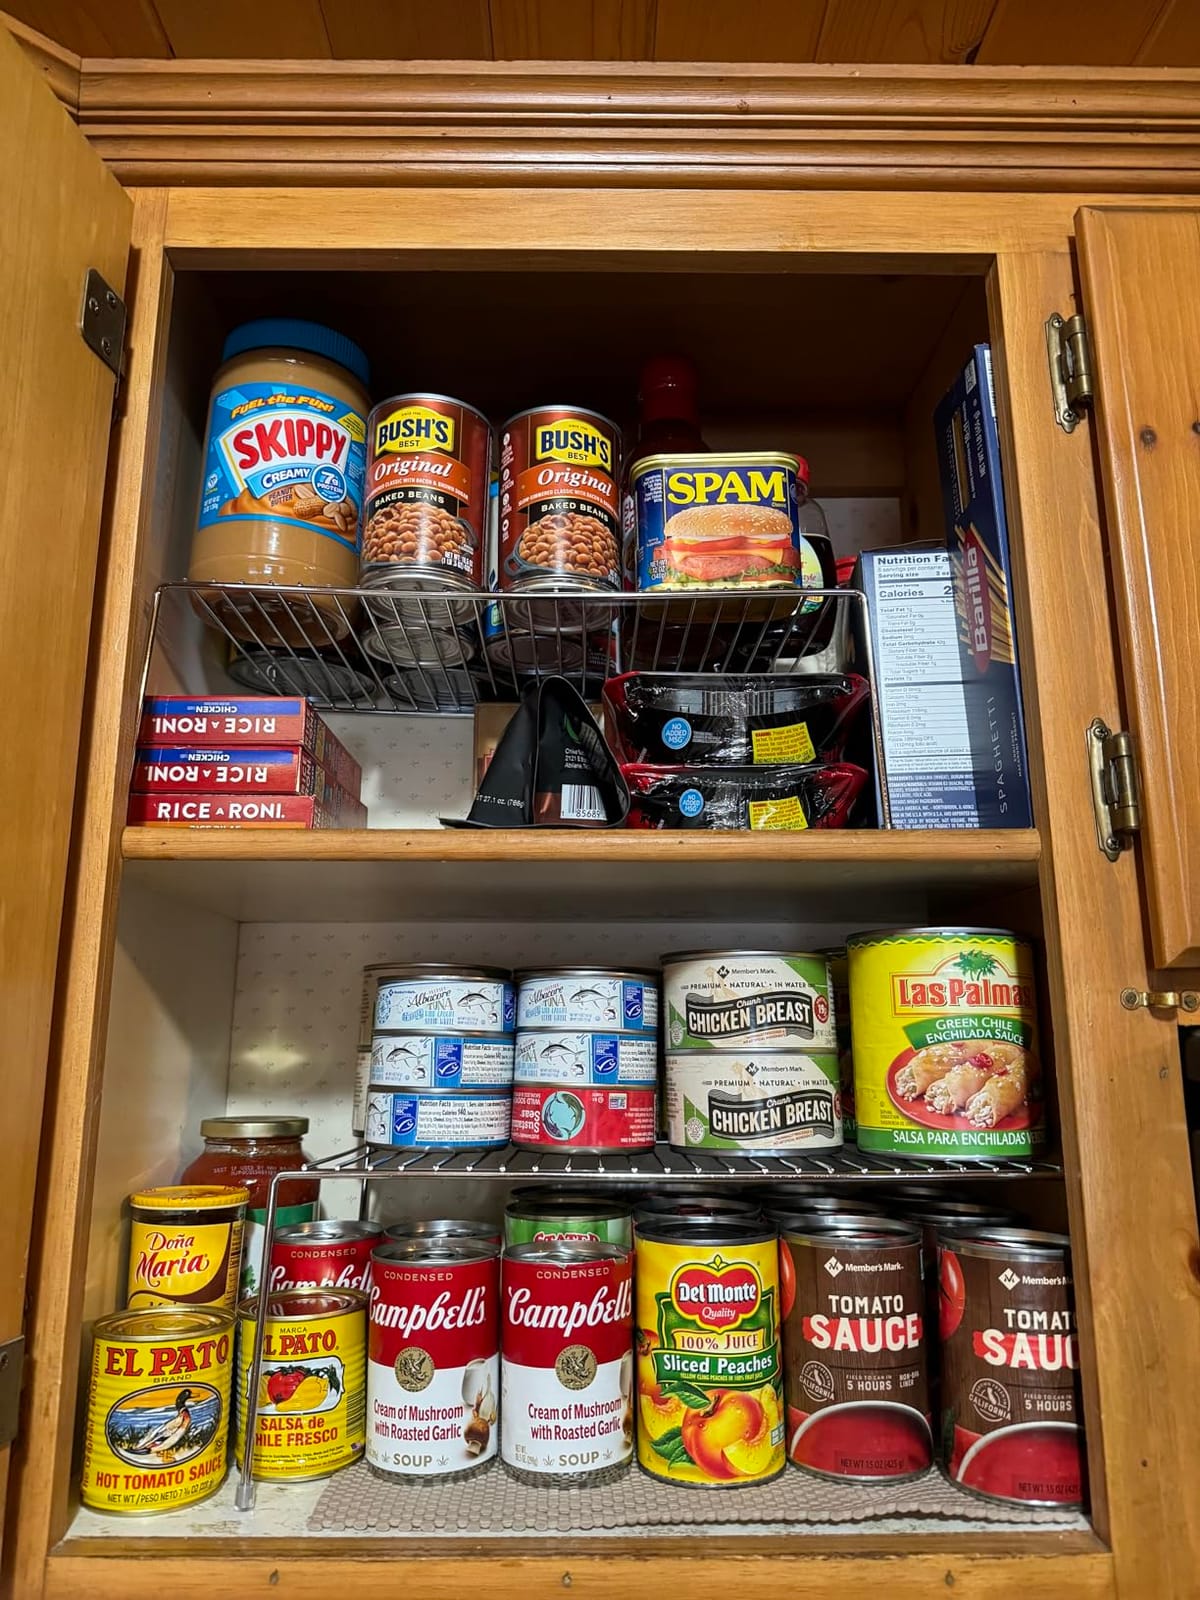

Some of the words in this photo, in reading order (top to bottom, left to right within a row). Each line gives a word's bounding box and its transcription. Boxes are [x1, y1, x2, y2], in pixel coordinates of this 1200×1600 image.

[230, 398, 265, 420] FUEL
[267, 393, 296, 405] the
[296, 395, 335, 413] FUN!
[379, 418, 449, 449] BUSH'S
[233, 418, 347, 470] SKIPPY
[399, 440, 421, 448] BEST
[541, 430, 610, 464] BUSH'S
[567, 452, 589, 462] BEST
[374, 455, 453, 481] Original
[262, 468, 310, 488] CREAMY
[537, 467, 612, 497] Original
[269, 487, 294, 500] PEANUT
[317, 482, 344, 495] PROTEIN
[667, 470, 786, 505] SPAM
[271, 494, 293, 507] BUTTER
[375, 491, 405, 508] BAKED
[408, 490, 445, 504] BEANS
[541, 502, 577, 512] BAKED
[580, 503, 609, 522] BEANS
[878, 556, 931, 565] Nutrition
[879, 589, 925, 599] Calories
[968, 547, 989, 652] Barilla
[195, 705, 238, 713] CHICKEN
[211, 721, 220, 729] A
[224, 718, 276, 734] RICE
[188, 753, 230, 762] CHICKEN
[986, 696, 1008, 814] SPAGHETTI
[203, 770, 212, 778] A
[215, 767, 268, 783] RICE
[157, 802, 211, 819] RICE
[215, 807, 225, 816] A
[690, 982, 721, 990] PREMIUM
[730, 981, 765, 989] NATURAL
[785, 981, 807, 989] WATER
[898, 978, 946, 1007] Las
[407, 989, 452, 1008] Albacore
[529, 986, 564, 1005] Albacore
[543, 994, 566, 1007] TUNA
[427, 998, 454, 1011] TUNA
[688, 1007, 750, 1033] CHICKEN
[756, 1002, 811, 1026] BREAST
[935, 1017, 978, 1030] GREEN
[981, 1017, 1013, 1031] CHILE
[925, 1028, 992, 1045] ENCHILADA
[994, 1027, 1025, 1046] SAUCE
[761, 1065, 789, 1073] Member's
[714, 1079, 751, 1087] PREMIUM
[759, 1079, 794, 1087] NATURAL
[457, 1108, 467, 1116] 140
[712, 1106, 781, 1134] CHICKEN
[785, 1100, 832, 1126] BREAST
[893, 1131, 925, 1145] SALSA
[927, 1131, 959, 1145] PARA
[962, 1131, 1026, 1145] ENCHILADAS
[145, 1231, 195, 1251] Doña
[291, 1248, 357, 1259] CONDENSED
[135, 1250, 210, 1288] María
[384, 1270, 454, 1282] CONDENSED
[536, 1267, 610, 1280] CONDENSED
[845, 1263, 883, 1273] Member's
[884, 1263, 901, 1272] Mark
[1022, 1275, 1061, 1286] Member's
[679, 1282, 706, 1304] Del
[708, 1282, 757, 1303] Monte
[370, 1286, 487, 1339] Campbell's
[828, 1294, 904, 1315] TOMATO
[702, 1306, 736, 1321] Quality
[1003, 1308, 1071, 1331] TOMAT
[809, 1312, 920, 1353] SAUCE
[279, 1329, 337, 1356] PATO
[681, 1335, 719, 1350] 100%
[724, 1333, 759, 1350] JUICE
[105, 1346, 144, 1377] EL
[148, 1334, 230, 1377] PATO
[663, 1354, 711, 1374] Sliced
[717, 1353, 773, 1375] Peaches
[153, 1373, 193, 1384] BRAND
[847, 1381, 854, 1391] 5
[857, 1380, 893, 1392] HOURS
[899, 1380, 914, 1389] LINER
[799, 1375, 835, 1400] CALIFORNIA
[84, 1418, 95, 1468] Original
[92, 1343, 101, 1391] Original
[374, 1398, 396, 1419] Cream
[397, 1405, 408, 1420] of
[409, 1405, 464, 1421] Mushroom
[528, 1402, 560, 1421] Cream
[561, 1402, 573, 1420] of
[574, 1398, 622, 1420] Mushroom
[969, 1393, 1011, 1421] CALIFORNIA
[1025, 1400, 1032, 1410] 5
[1036, 1400, 1073, 1412] HOURS
[261, 1416, 304, 1431] SALSA
[308, 1415, 325, 1430] de
[374, 1420, 390, 1438] with
[391, 1423, 430, 1441] Roasted
[432, 1423, 462, 1441] Garlic
[531, 1424, 553, 1441] with
[554, 1421, 597, 1441] Roasted
[597, 1416, 621, 1437] Garlic
[255, 1432, 283, 1447] HILE
[287, 1427, 338, 1447] FRESCO
[393, 1453, 433, 1467] SOUP
[559, 1451, 600, 1467] SOUP
[840, 1458, 852, 1468] NET
[853, 1459, 864, 1469] WT
[96, 1471, 121, 1490] HOT
[124, 1469, 185, 1490] TOMATO
[189, 1454, 223, 1481] SAUCE
[107, 1493, 123, 1503] NET
[160, 1490, 178, 1501] NETO
[179, 1488, 184, 1497] 7
